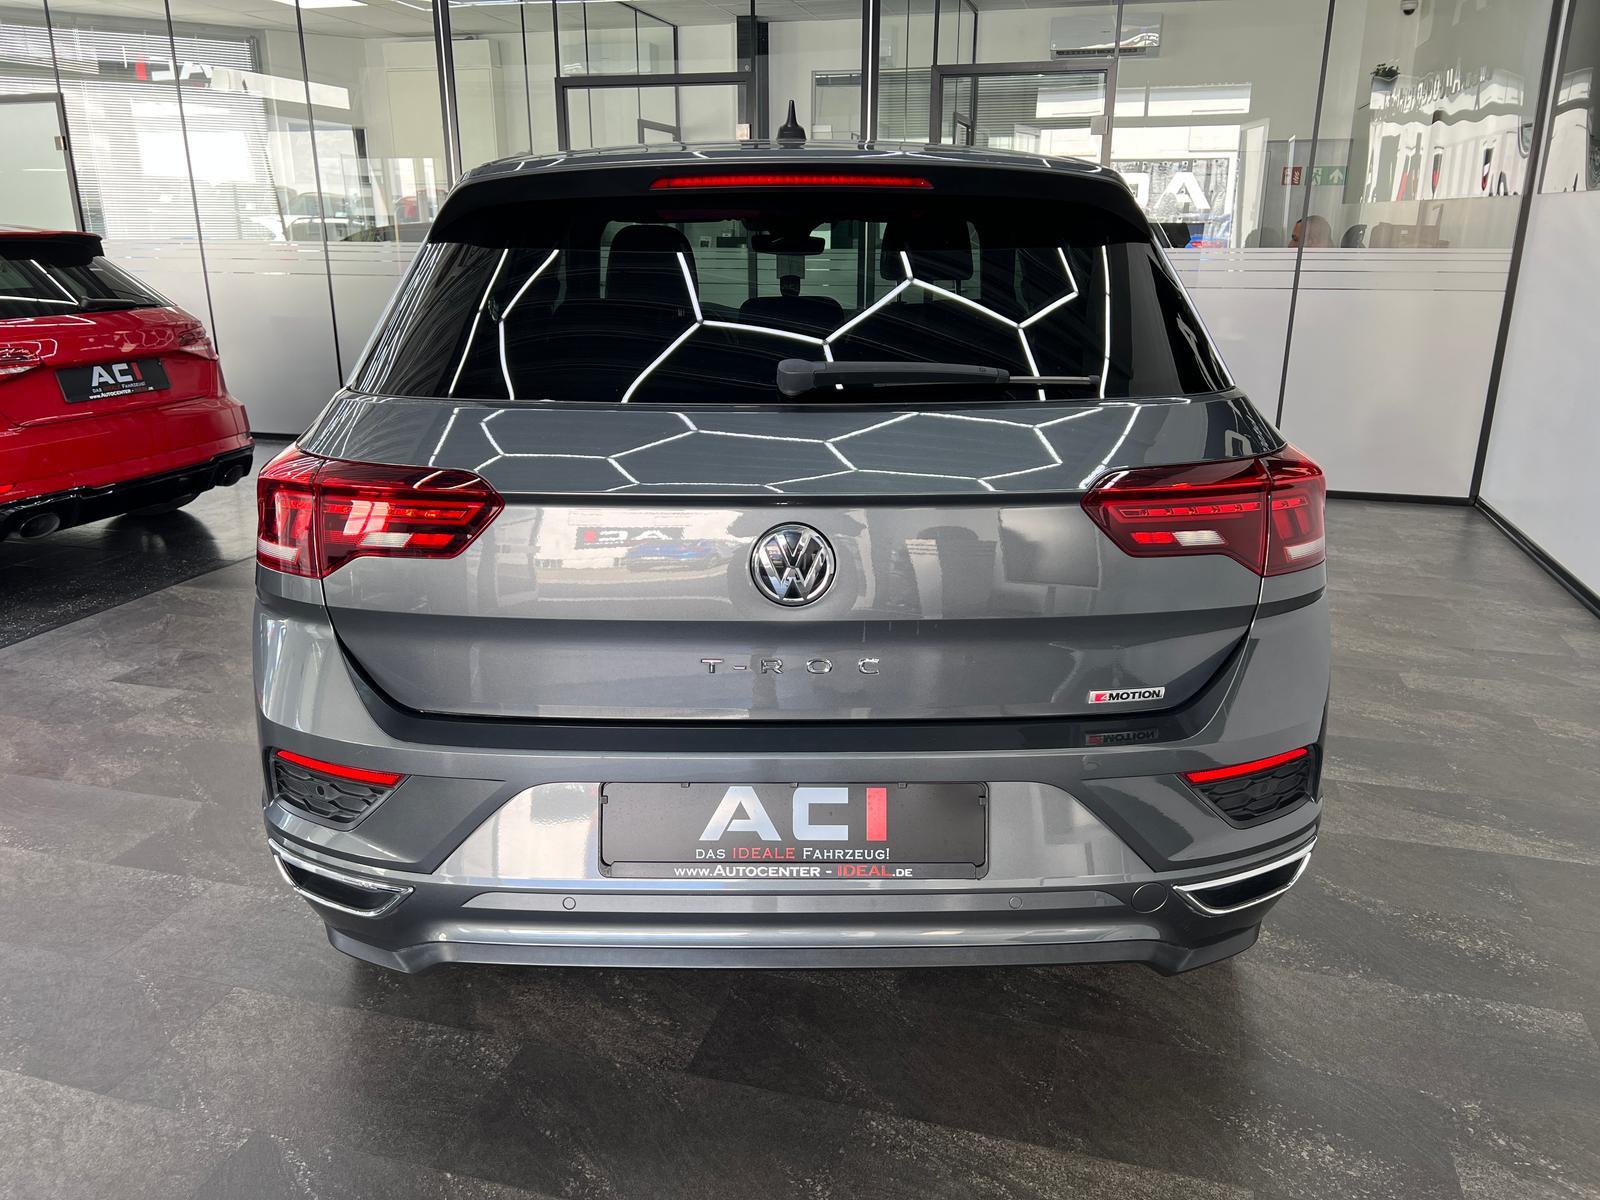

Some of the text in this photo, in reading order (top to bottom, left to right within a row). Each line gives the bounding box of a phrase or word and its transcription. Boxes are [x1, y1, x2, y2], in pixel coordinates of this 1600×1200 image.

[91, 362, 143, 387] ACI
[700, 657, 880, 675] T-ROC
[698, 785, 888, 842] ACI
[695, 847, 891, 861] DAS IDEALE FAHRZEUG!
